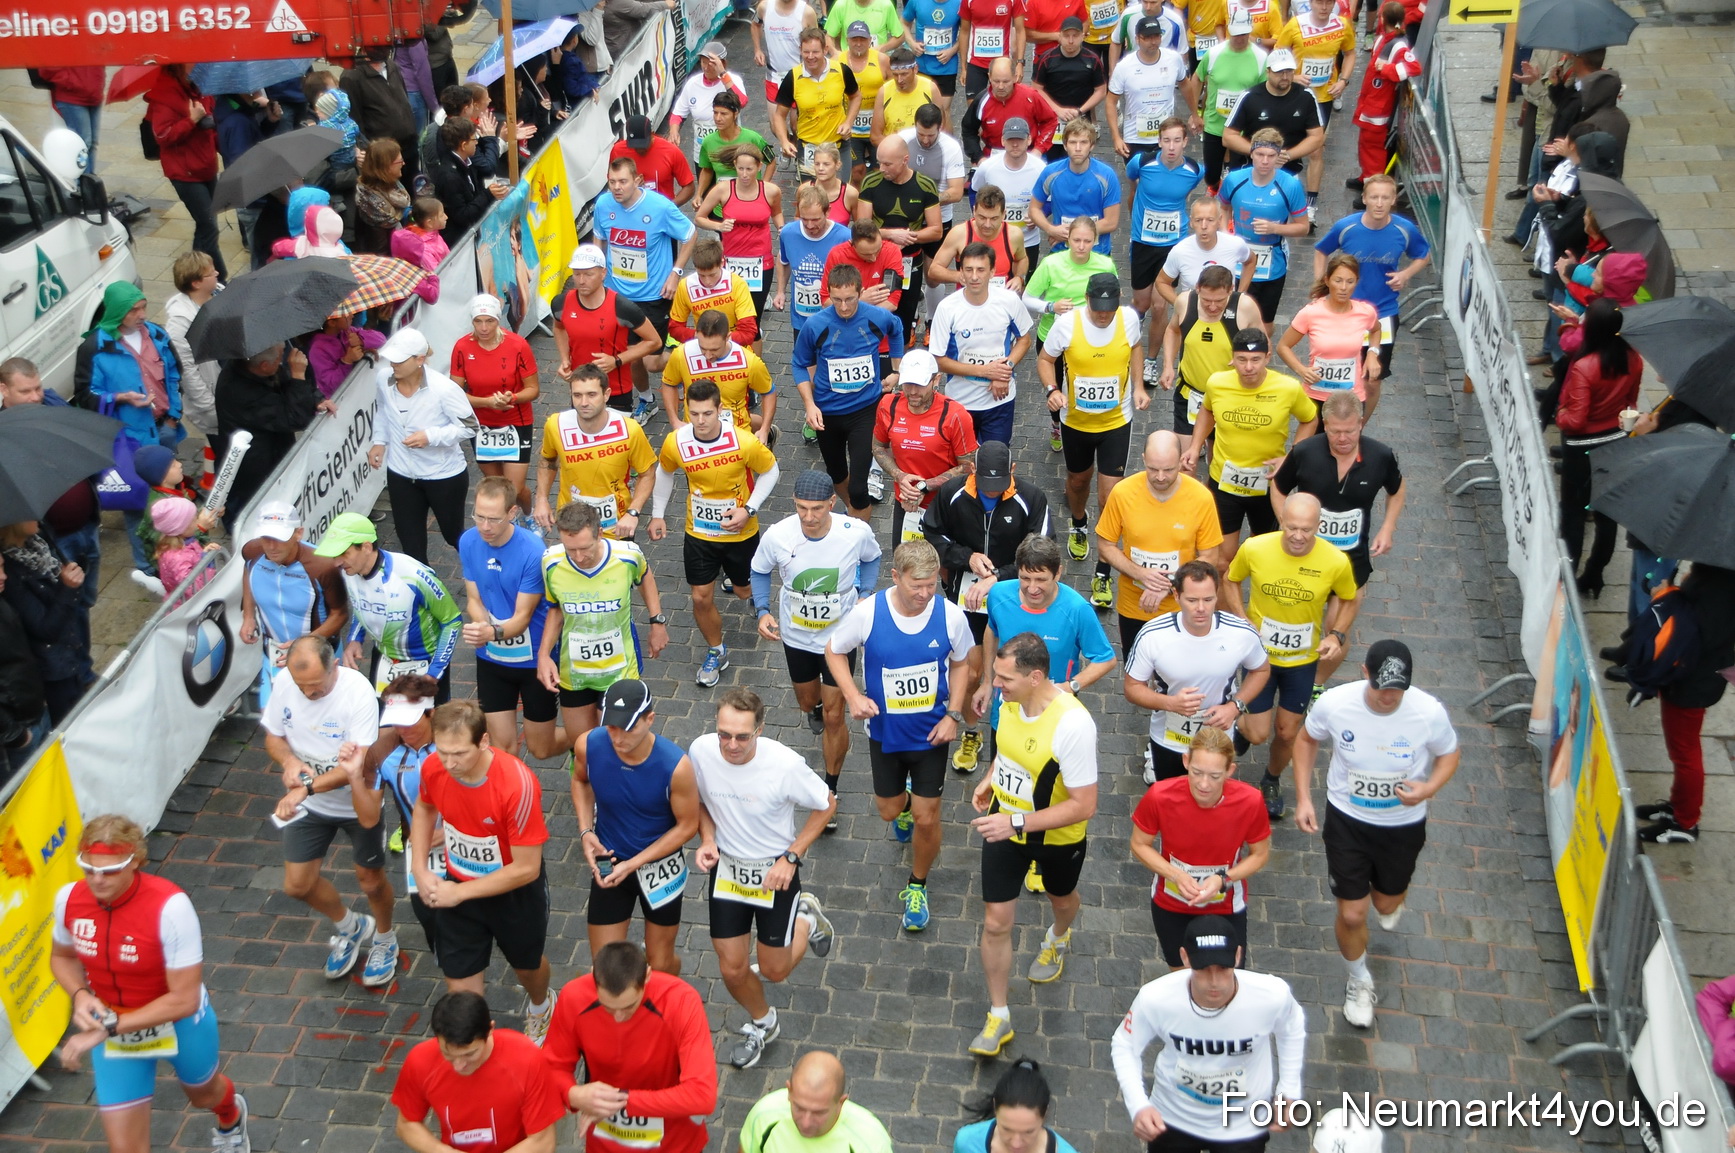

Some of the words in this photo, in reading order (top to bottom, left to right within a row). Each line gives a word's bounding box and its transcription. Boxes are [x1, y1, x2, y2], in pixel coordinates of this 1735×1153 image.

[1092, 6, 1117, 20] 2852
[0, 10, 80, 37] eline:
[87, 10, 170, 35] 09181
[179, 6, 252, 31] 6352
[926, 33, 950, 46] 2115
[976, 35, 1001, 47] 2555
[1304, 65, 1330, 77] 2914
[1146, 217, 1176, 232] 2716
[611, 230, 646, 247] Lete
[620, 256, 636, 271] 37
[692, 302, 712, 312] MAX
[713, 295, 735, 307] BÖGL
[720, 371, 750, 383] BÖGL
[833, 365, 871, 383] 3133
[1317, 367, 1352, 381] 3042
[1078, 386, 1115, 401] 2873
[1085, 402, 1107, 410] Ludwig
[481, 432, 516, 447] 3138
[566, 452, 594, 464] MAX
[597, 443, 631, 459] BÖGL
[685, 460, 711, 474] MAX
[713, 453, 743, 468] BÖGL
[96, 483, 132, 493] adidas
[1230, 473, 1260, 488] 447
[1318, 519, 1359, 536] 3048
[415, 568, 446, 601] BOCK
[561, 591, 600, 601] TEAM
[1266, 585, 1309, 601] FRANCESCO
[563, 598, 622, 615] BOCK
[799, 605, 831, 620] 412
[803, 619, 827, 629] Rainer
[440, 628, 459, 663] BOCK
[1269, 631, 1303, 649] 443
[580, 641, 614, 660] 549
[902, 668, 930, 678] Neumarkt
[894, 676, 930, 697] 309
[897, 697, 930, 708] Winfried
[998, 768, 1024, 796] 517
[449, 835, 496, 863] 2048
[645, 850, 686, 890] 2481
[729, 864, 763, 886] 155
[730, 883, 760, 898] Thomas
[120, 943, 137, 953] GER
[1195, 934, 1227, 948] THULE
[20, 979, 59, 1024] Gartenm
[1168, 1032, 1254, 1057] THULE
[1181, 1075, 1240, 1096] 2426
